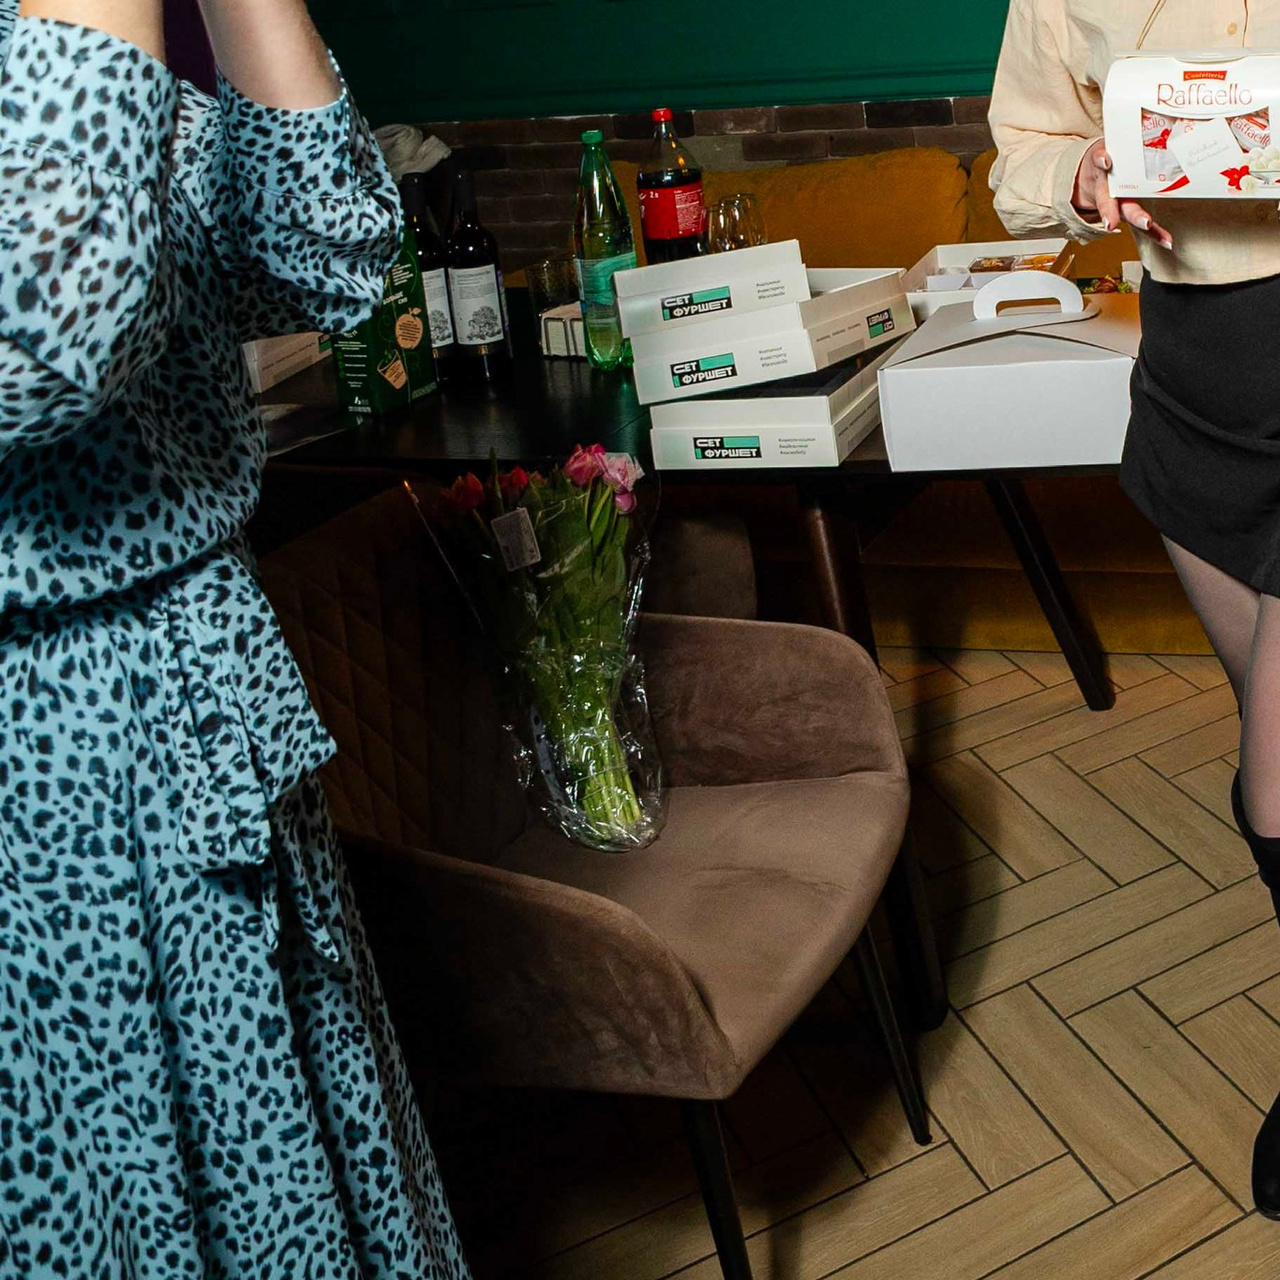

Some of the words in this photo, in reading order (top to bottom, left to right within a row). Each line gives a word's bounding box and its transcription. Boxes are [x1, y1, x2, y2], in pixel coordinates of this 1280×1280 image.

[1157, 84, 1252, 108] Raffaello
[664, 295, 691, 308] СЕТ
[673, 299, 729, 317] ФУРШЕТ
[673, 362, 697, 373] СЕТ
[682, 366, 734, 384] ФУРШЕТ
[696, 438, 722, 448] СЕТ
[704, 448, 759, 458] ФУРШЕТ
